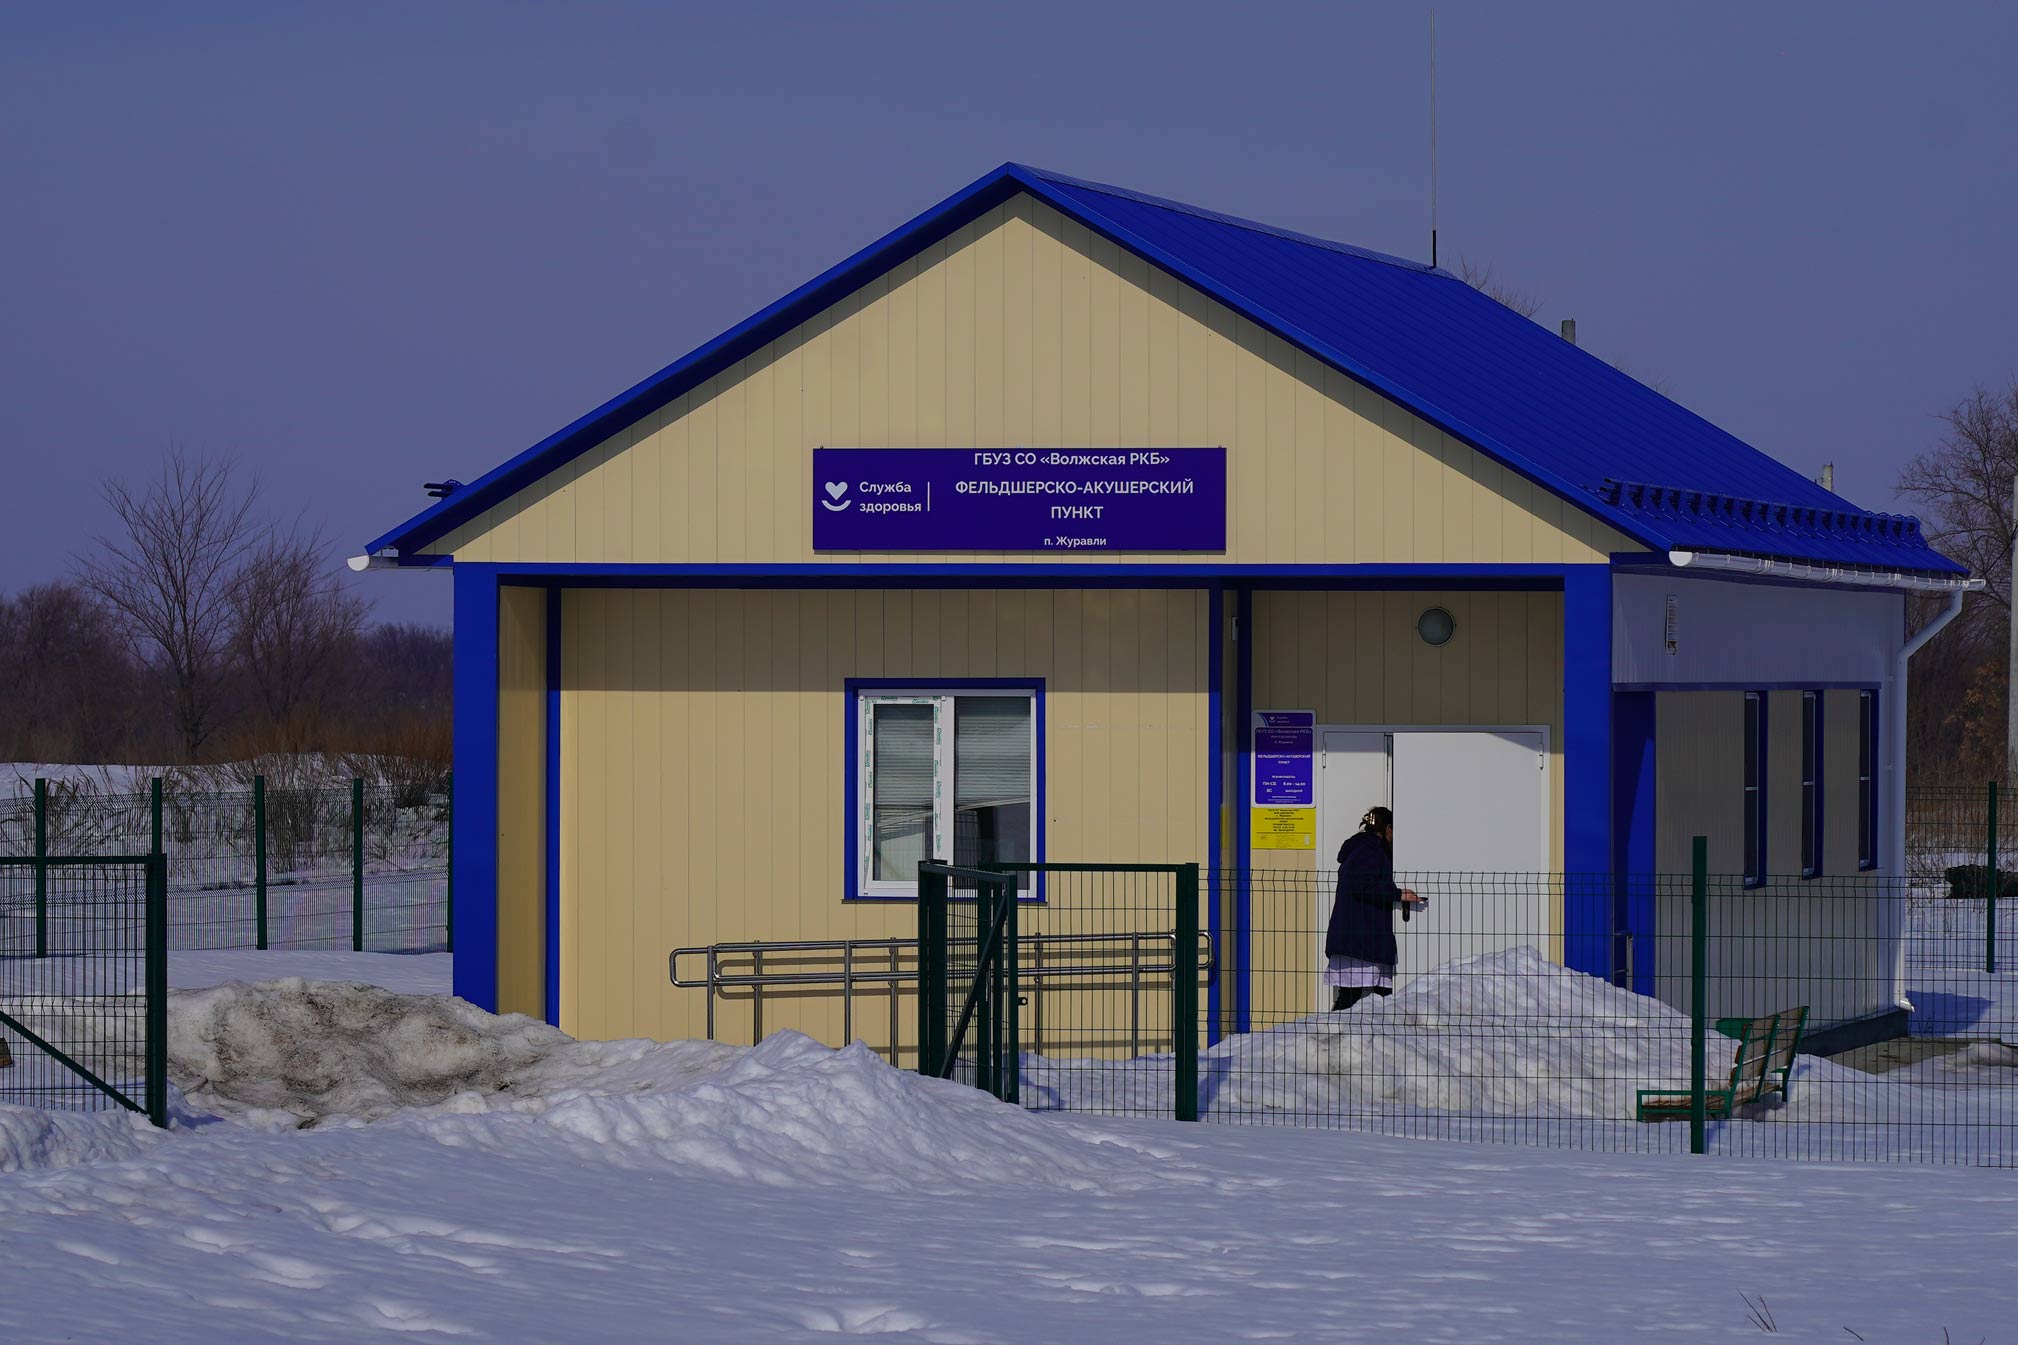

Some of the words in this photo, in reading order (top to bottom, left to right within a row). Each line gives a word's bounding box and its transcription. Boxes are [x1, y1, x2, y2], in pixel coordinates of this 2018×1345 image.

[974, 452, 1011, 466] ГБУЗ
[1014, 452, 1037, 466] СО
[1039, 452, 1126, 466] «Волжская
[1129, 452, 1170, 466] РКБ»
[859, 481, 912, 495] Служба
[955, 479, 1194, 496] ФЕЛЬДШЕРСКО-АКУШЕРСКИЙ
[859, 501, 922, 514] здоровья
[1050, 505, 1104, 519] ПУНКТ
[1043, 538, 1054, 546] п.
[1055, 536, 1107, 548] Журавли
